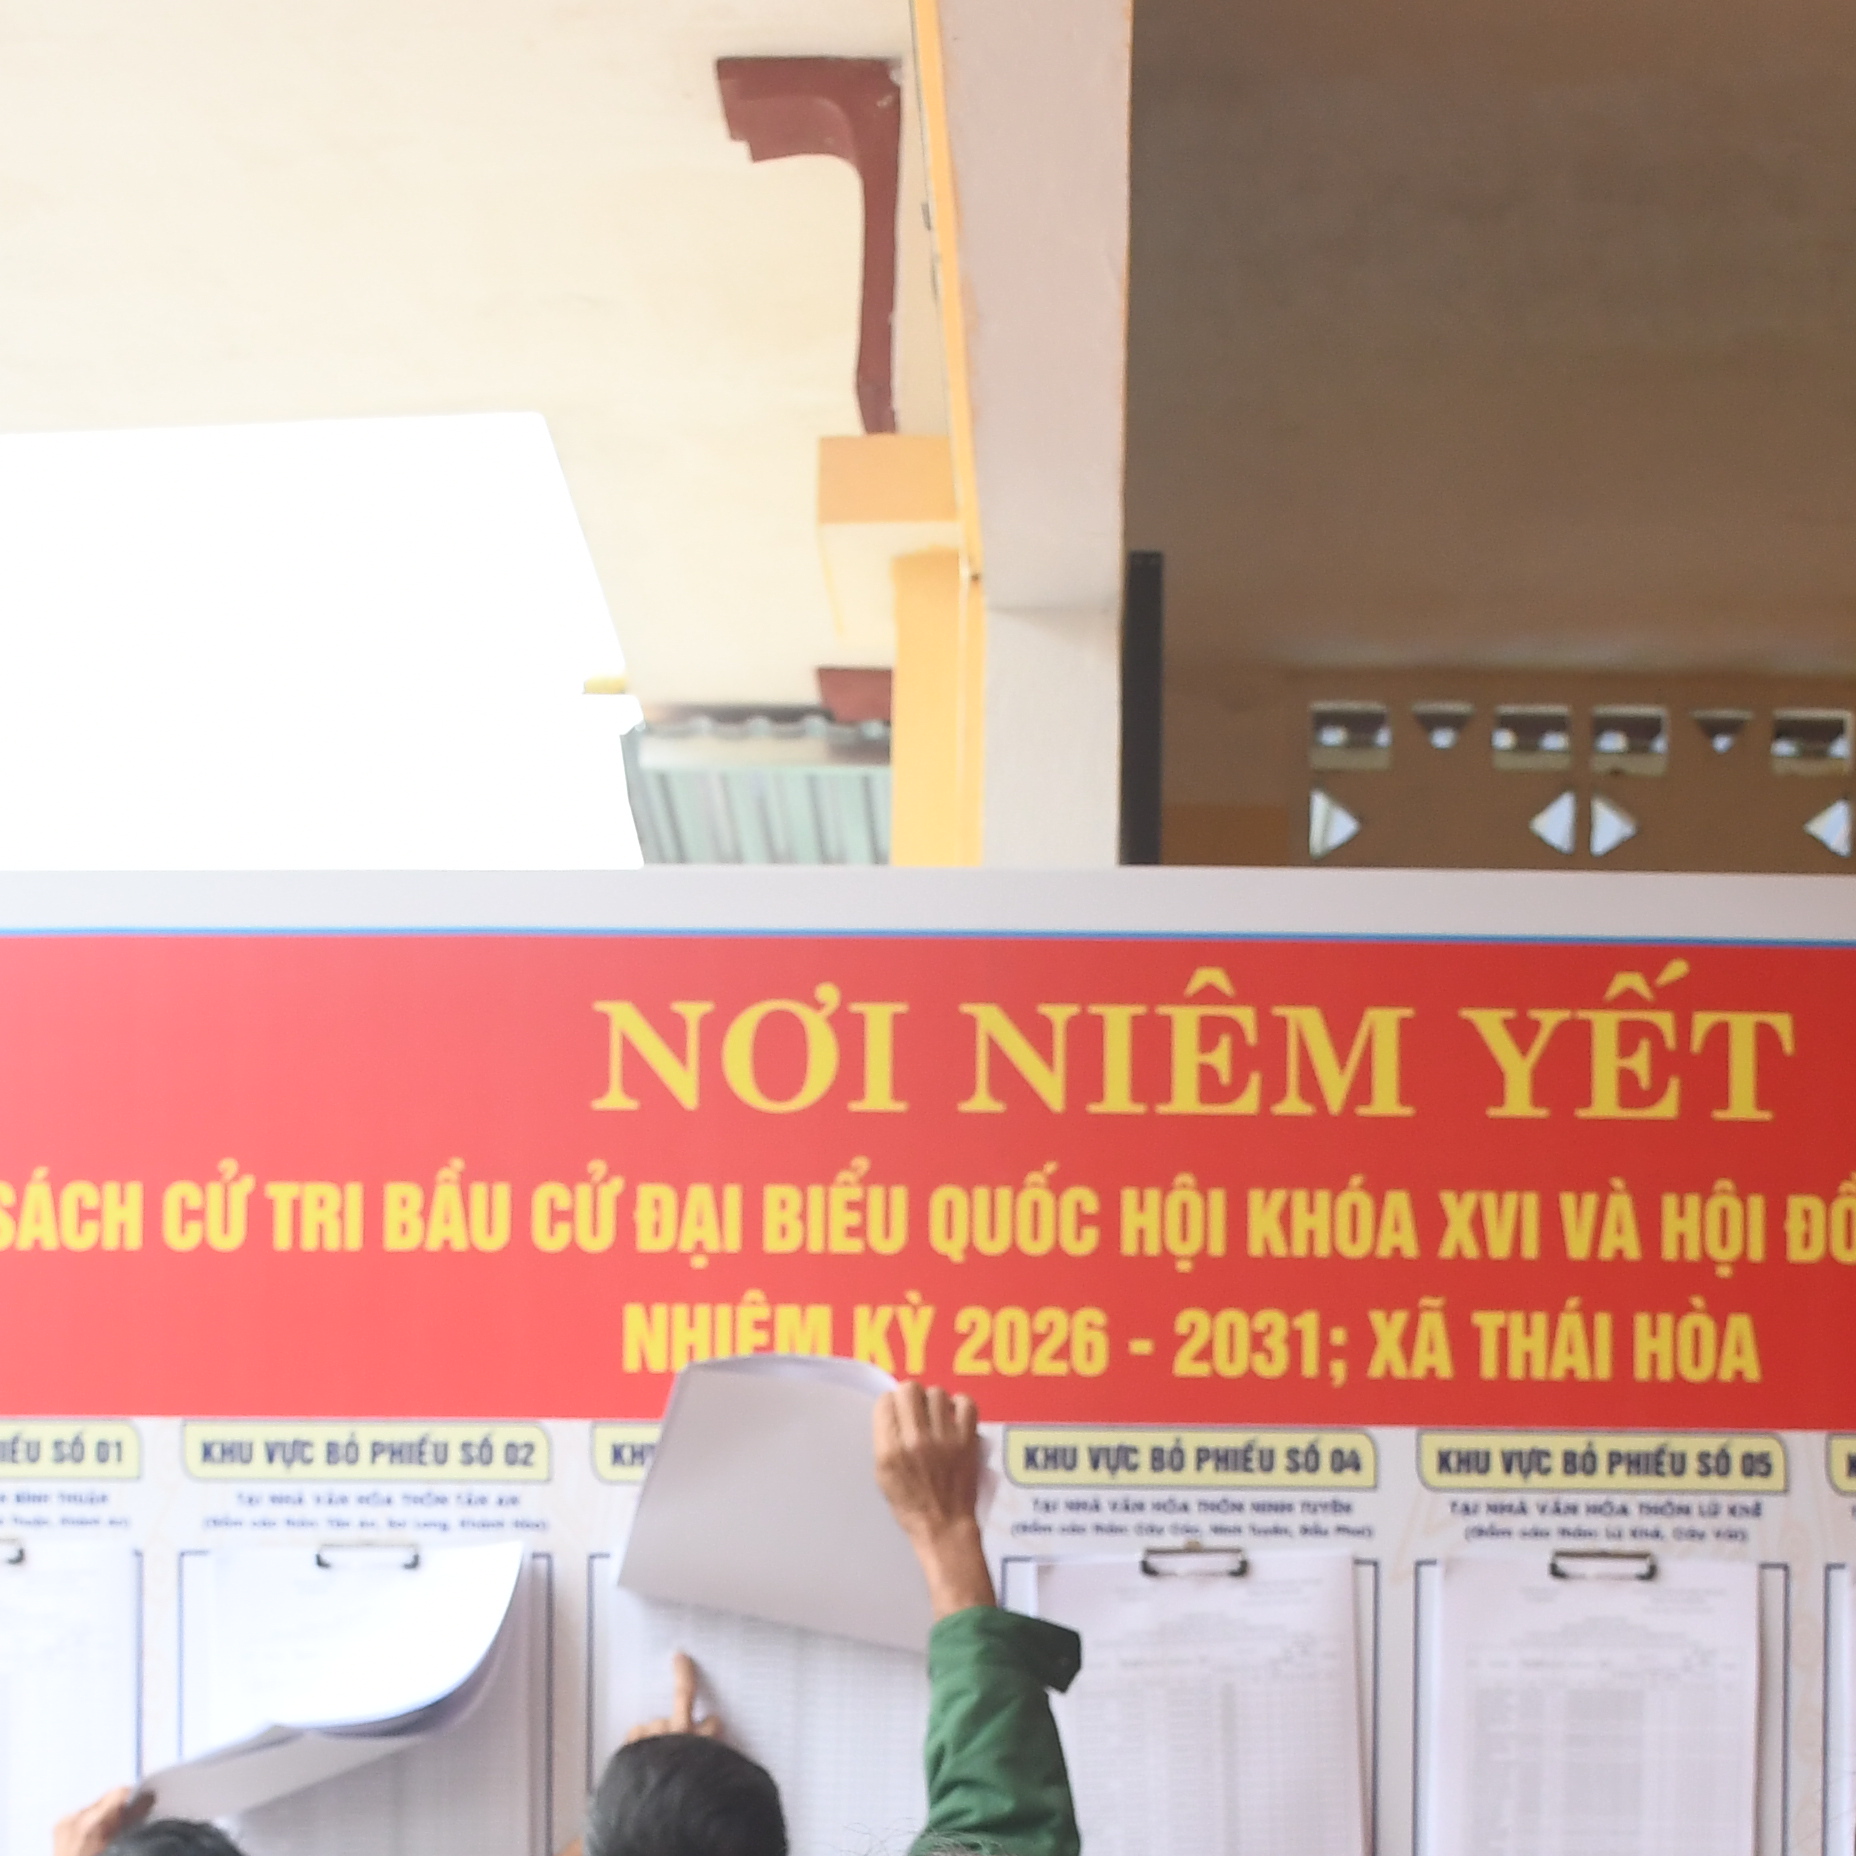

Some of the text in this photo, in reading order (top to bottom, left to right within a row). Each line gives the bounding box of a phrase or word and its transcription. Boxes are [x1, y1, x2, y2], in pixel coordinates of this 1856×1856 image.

[594, 960, 1795, 1121] NƠI NIÊM YẾT
[164, 1161, 254, 1250] CỬ
[267, 1183, 362, 1250] TRI
[385, 1158, 510, 1250] BẦU
[533, 1162, 624, 1251] CỬ
[636, 1184, 741, 1266] ĐẠI
[765, 1157, 909, 1253] BIỂU
[930, 1162, 1099, 1262] QUỐC
[1122, 1173, 1226, 1272] HỘI
[1249, 1175, 1419, 1258] KHÓA
[1440, 1190, 1540, 1258] XVI
[1561, 1178, 1641, 1260] VÀ
[1662, 1179, 1765, 1277] HỘI
[853, 1290, 936, 1374] KỲ
[953, 1306, 1110, 1377] 2026
[1130, 1338, 1154, 1355] -
[1174, 1307, 1348, 1386] 2031;
[1369, 1295, 1454, 1380] XÃ
[1473, 1297, 1614, 1381] THÁI
[1635, 1294, 1762, 1383] HÒA
[52, 1431, 86, 1464] SỐ
[200, 1441, 253, 1466] KHU
[264, 1439, 314, 1470] VỰC
[370, 1433, 449, 1467] PHIẾU
[460, 1433, 494, 1467] SỐ
[504, 1441, 536, 1468] 02
[1023, 1446, 1078, 1472] KHU
[1088, 1444, 1140, 1477] VỰC
[1195, 1439, 1276, 1474] PHIẾU
[1285, 1438, 1321, 1475] SỐ
[1436, 1449, 1491, 1476] KHU
[1501, 1447, 1552, 1481] VỰC
[1607, 1443, 1687, 1478] PHIẾU
[1697, 1442, 1733, 1478] SỐ
